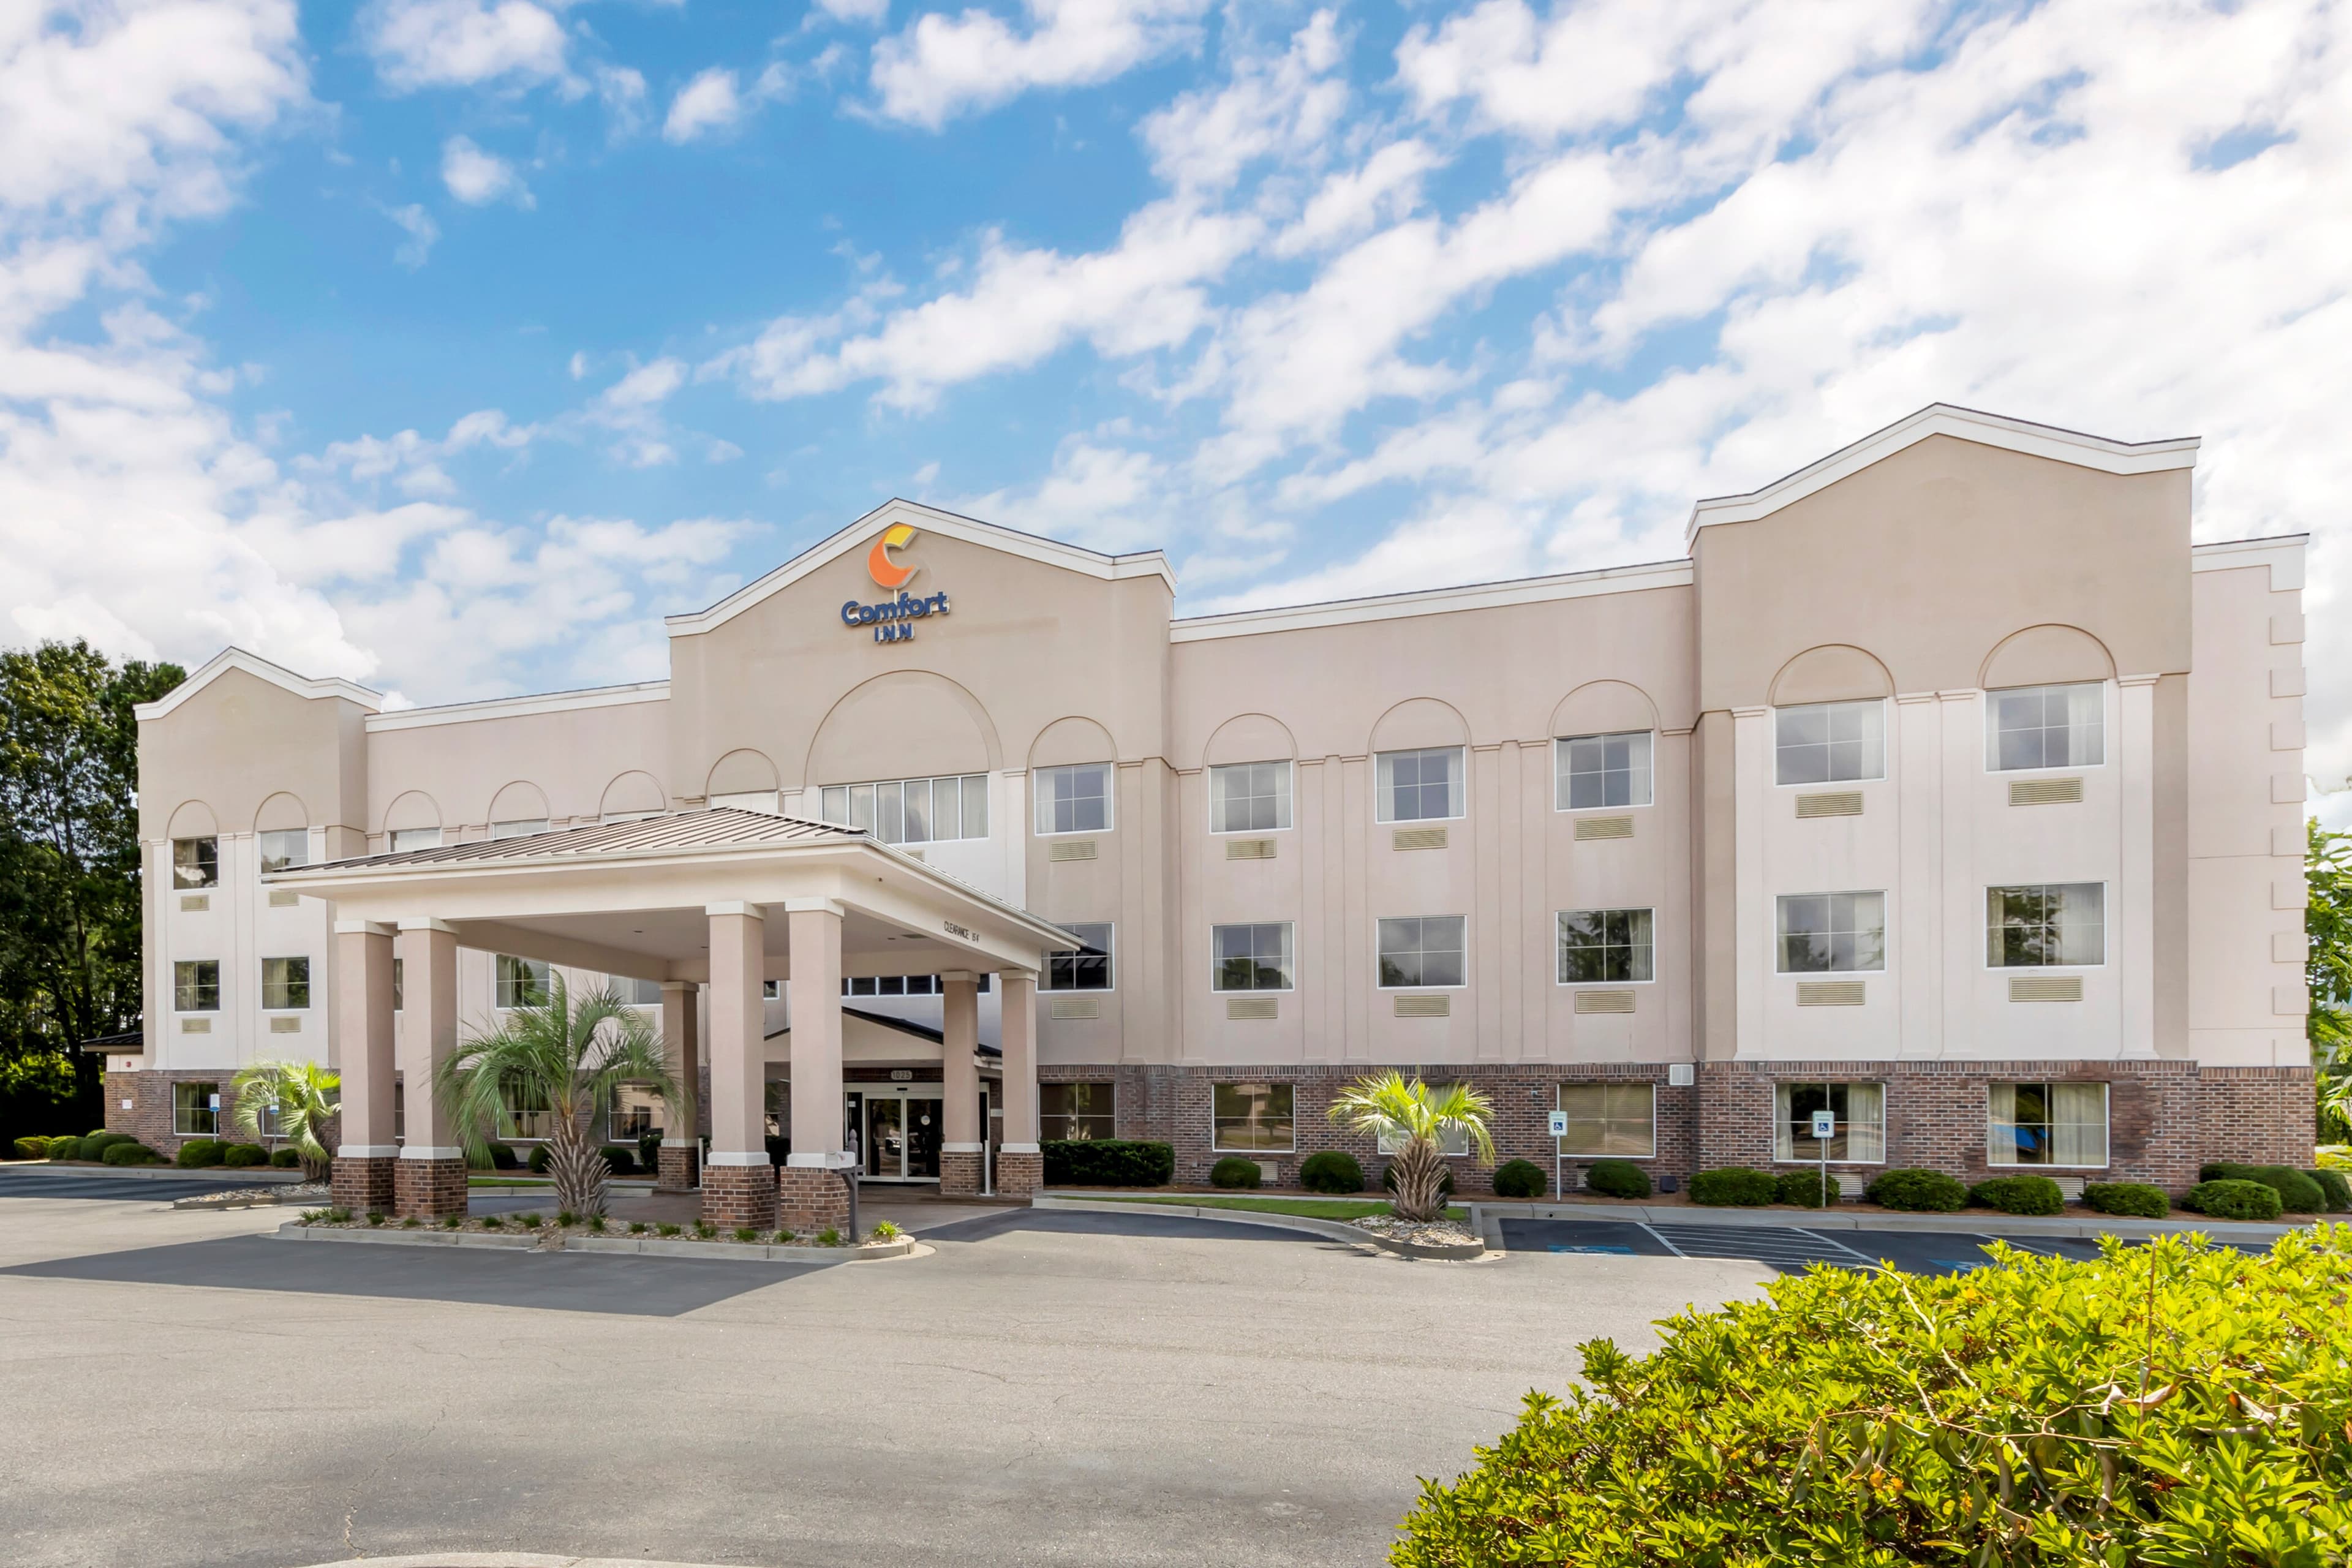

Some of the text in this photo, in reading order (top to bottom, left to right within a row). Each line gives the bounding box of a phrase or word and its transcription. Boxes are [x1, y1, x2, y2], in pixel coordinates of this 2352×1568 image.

[841, 591, 948, 625] Comfort
[874, 623, 913, 642] INN
[944, 921, 969, 940] CLEARANCE
